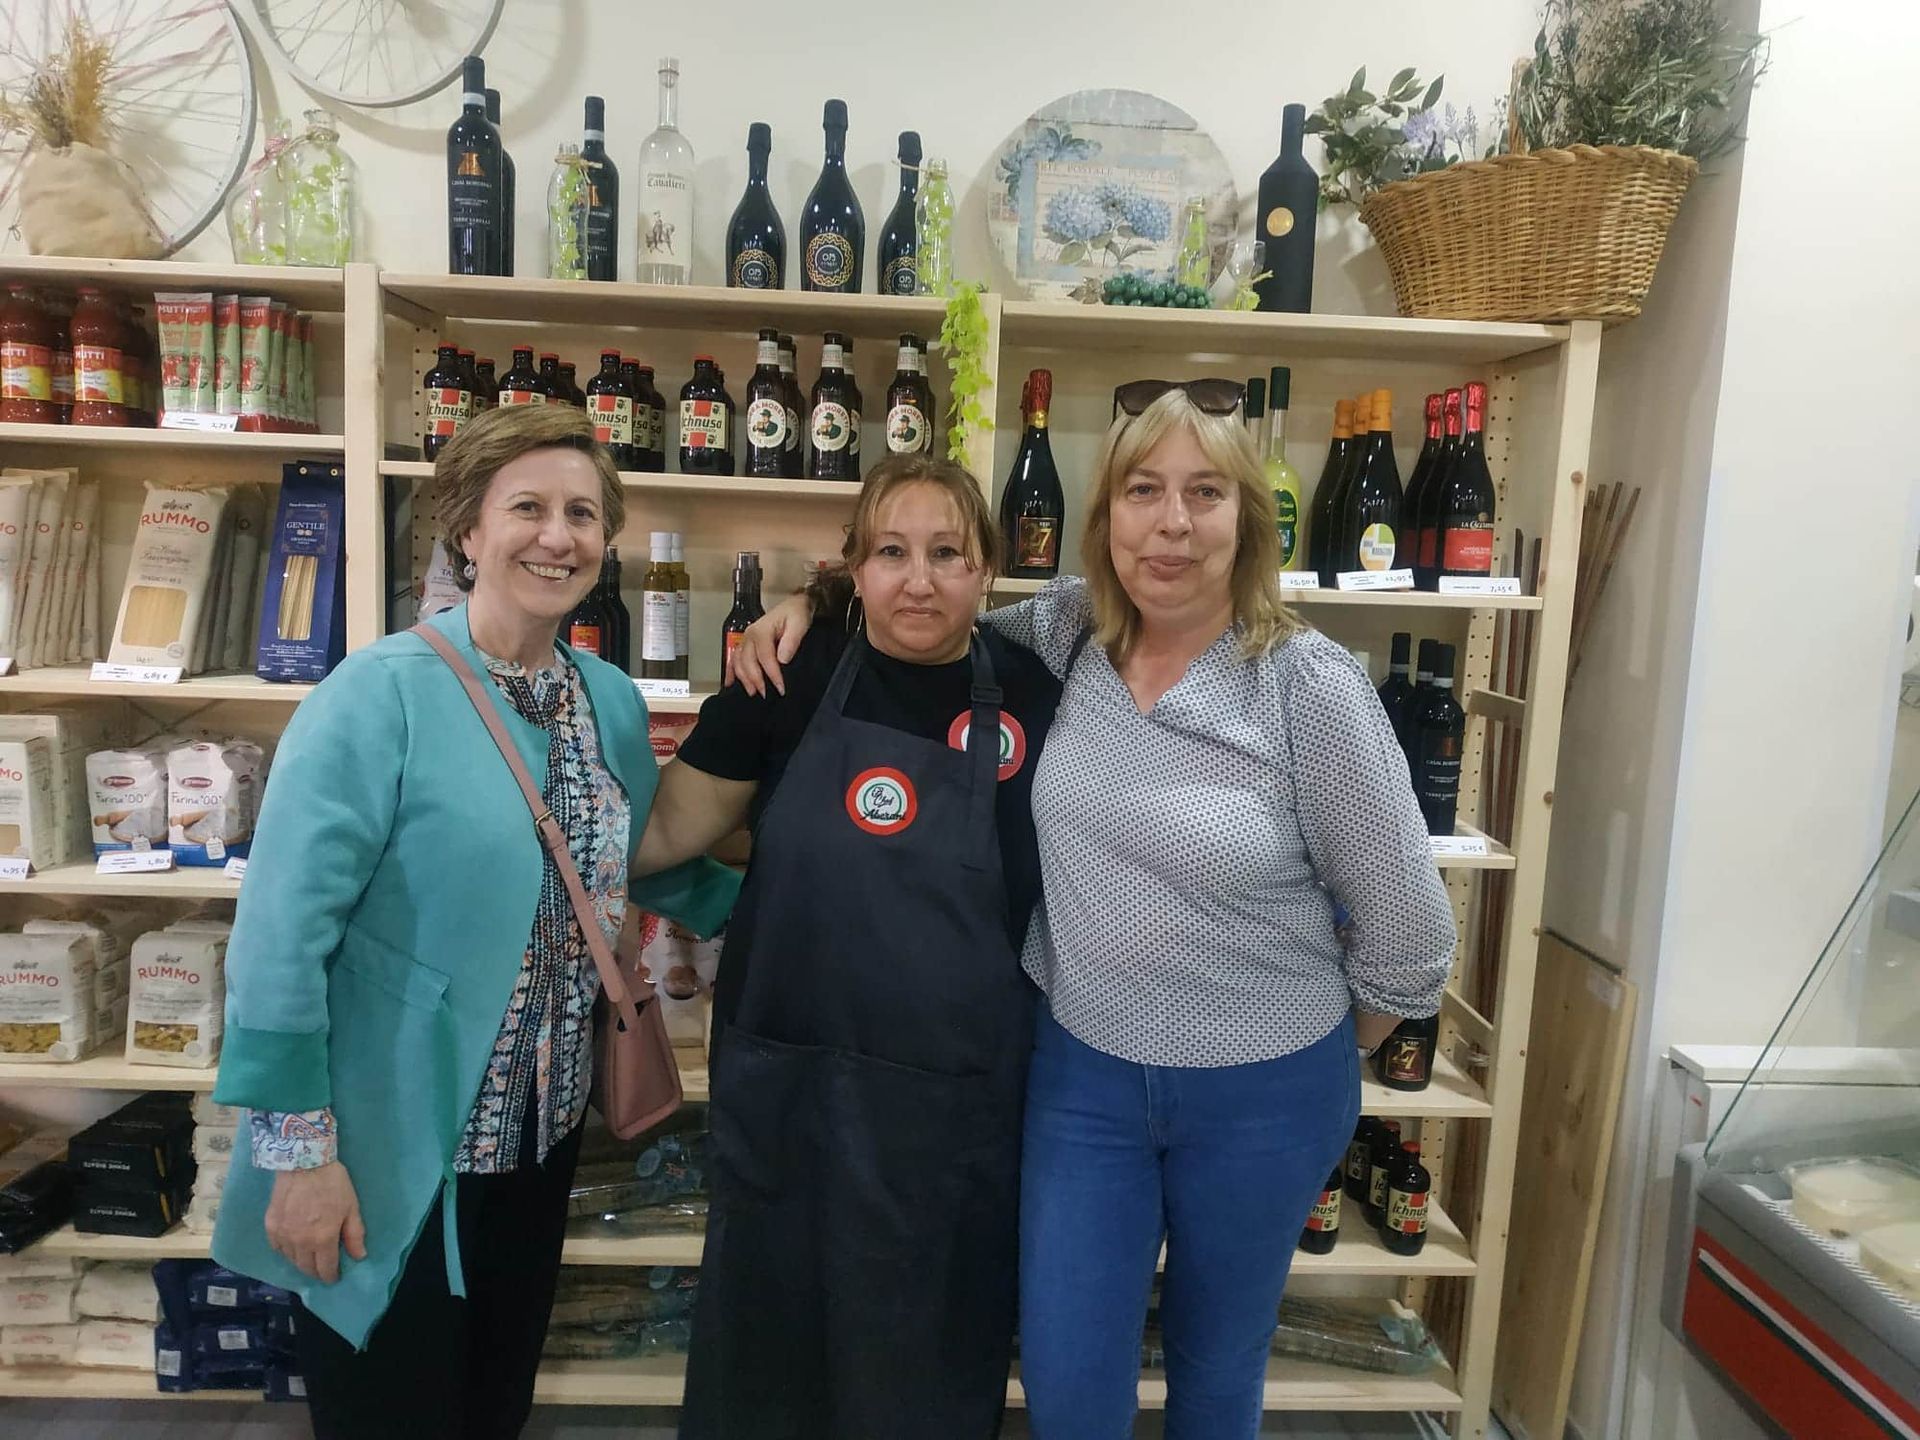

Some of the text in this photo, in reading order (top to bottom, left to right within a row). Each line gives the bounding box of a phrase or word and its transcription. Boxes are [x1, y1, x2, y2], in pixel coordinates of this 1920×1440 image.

[141, 512, 210, 534] RUMMO
[286, 521, 325, 530] GENTILE
[651, 741, 676, 752] nomi
[138, 966, 200, 985] RUMMO
